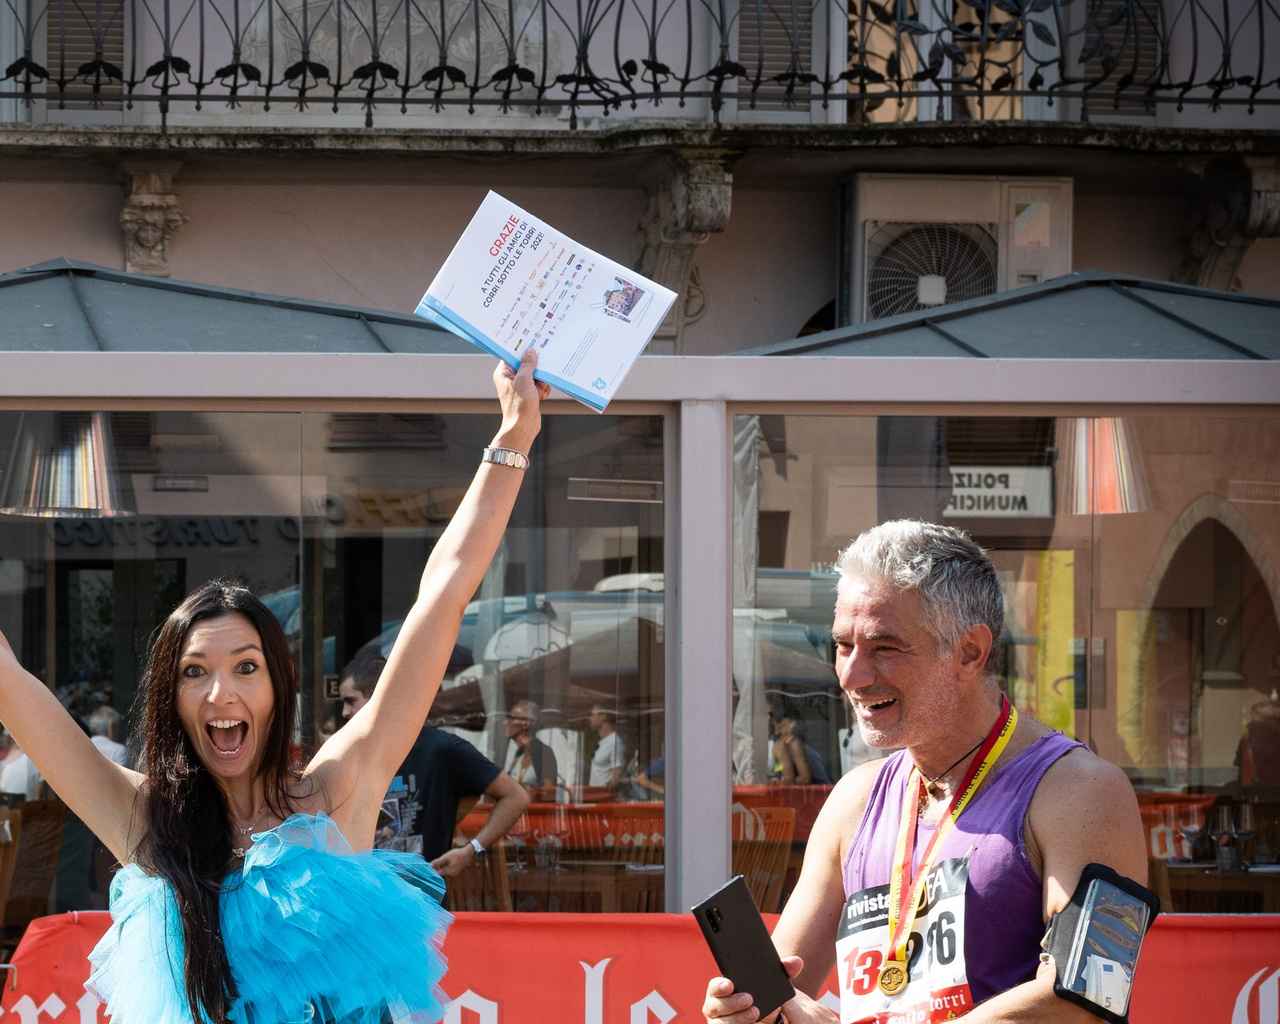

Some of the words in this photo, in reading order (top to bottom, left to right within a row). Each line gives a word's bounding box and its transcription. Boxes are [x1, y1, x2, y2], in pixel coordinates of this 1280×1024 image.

[484, 265, 501, 286] TUTTI
[497, 252, 509, 265] GLI
[505, 230, 523, 253] AMICI
[519, 221, 528, 230] DI
[488, 214, 521, 257] GRAZIE
[530, 232, 545, 251] 2021!
[482, 284, 500, 308] CORRI
[497, 259, 516, 285] SOTTO
[513, 249, 522, 259] LE
[519, 227, 537, 249] TORRI
